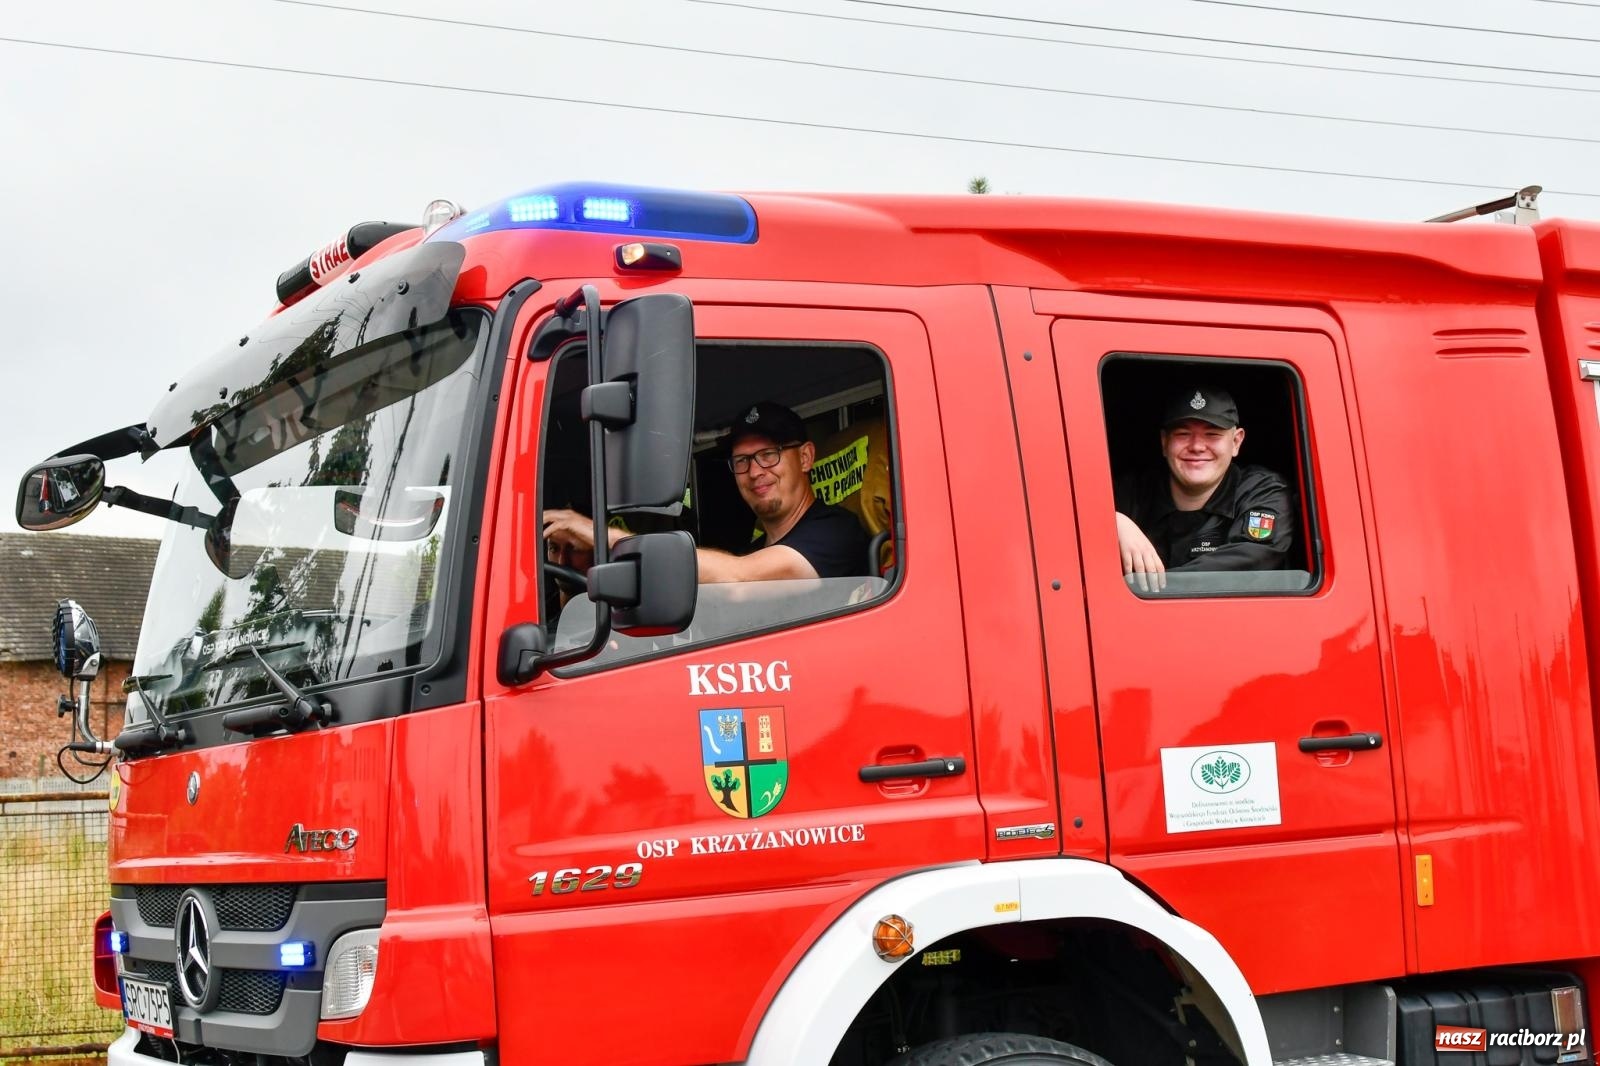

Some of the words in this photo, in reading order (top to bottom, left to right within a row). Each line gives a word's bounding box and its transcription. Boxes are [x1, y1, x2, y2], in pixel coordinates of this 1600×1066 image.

[686, 660, 792, 696] KSRG
[637, 839, 679, 859] OSP
[690, 823, 865, 855] KRZYŻANOWICE
[528, 862, 643, 896] 1629
[126, 982, 145, 1020] SRC
[144, 986, 171, 1025] 75P5
